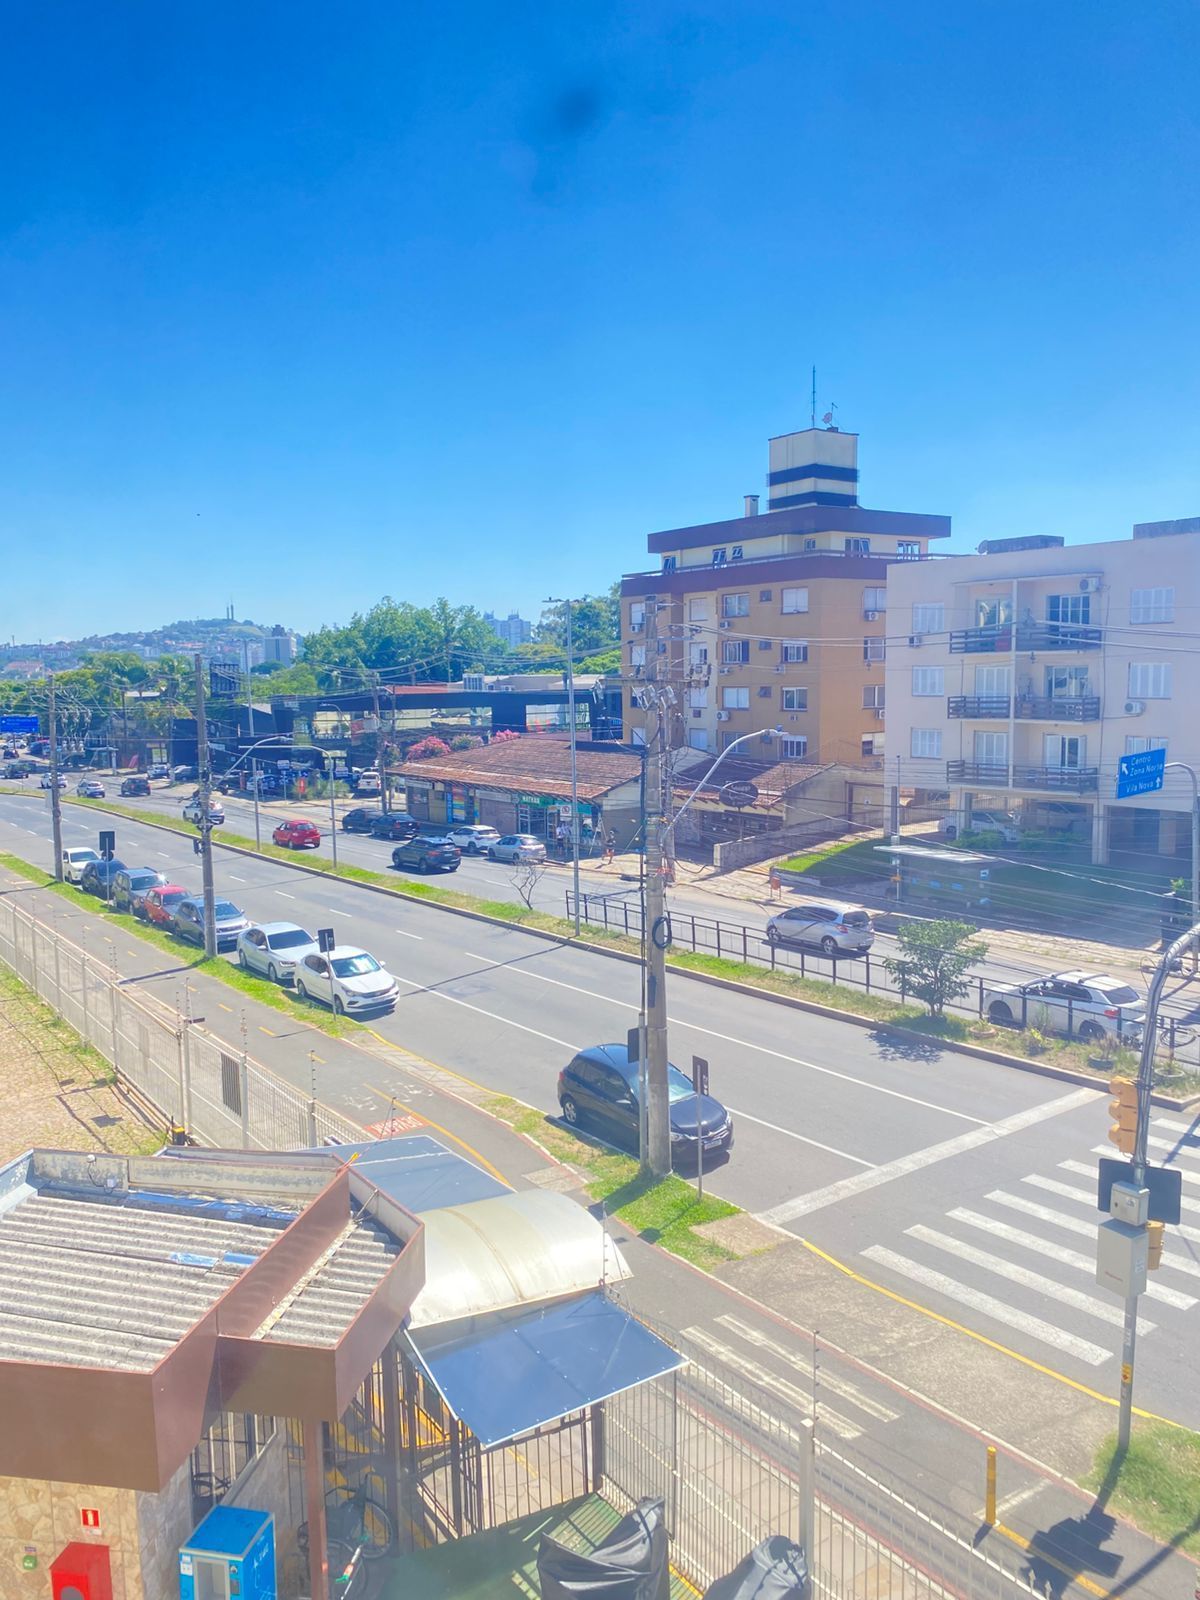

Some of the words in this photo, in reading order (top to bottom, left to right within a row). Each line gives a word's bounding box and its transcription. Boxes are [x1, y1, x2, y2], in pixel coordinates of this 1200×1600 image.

[1131, 755, 1151, 765] Centro
[1130, 767, 1145, 777] Zona
[1146, 763, 1163, 773] Norte
[1126, 784, 1138, 793] Vila
[1139, 781, 1154, 791] Nova
